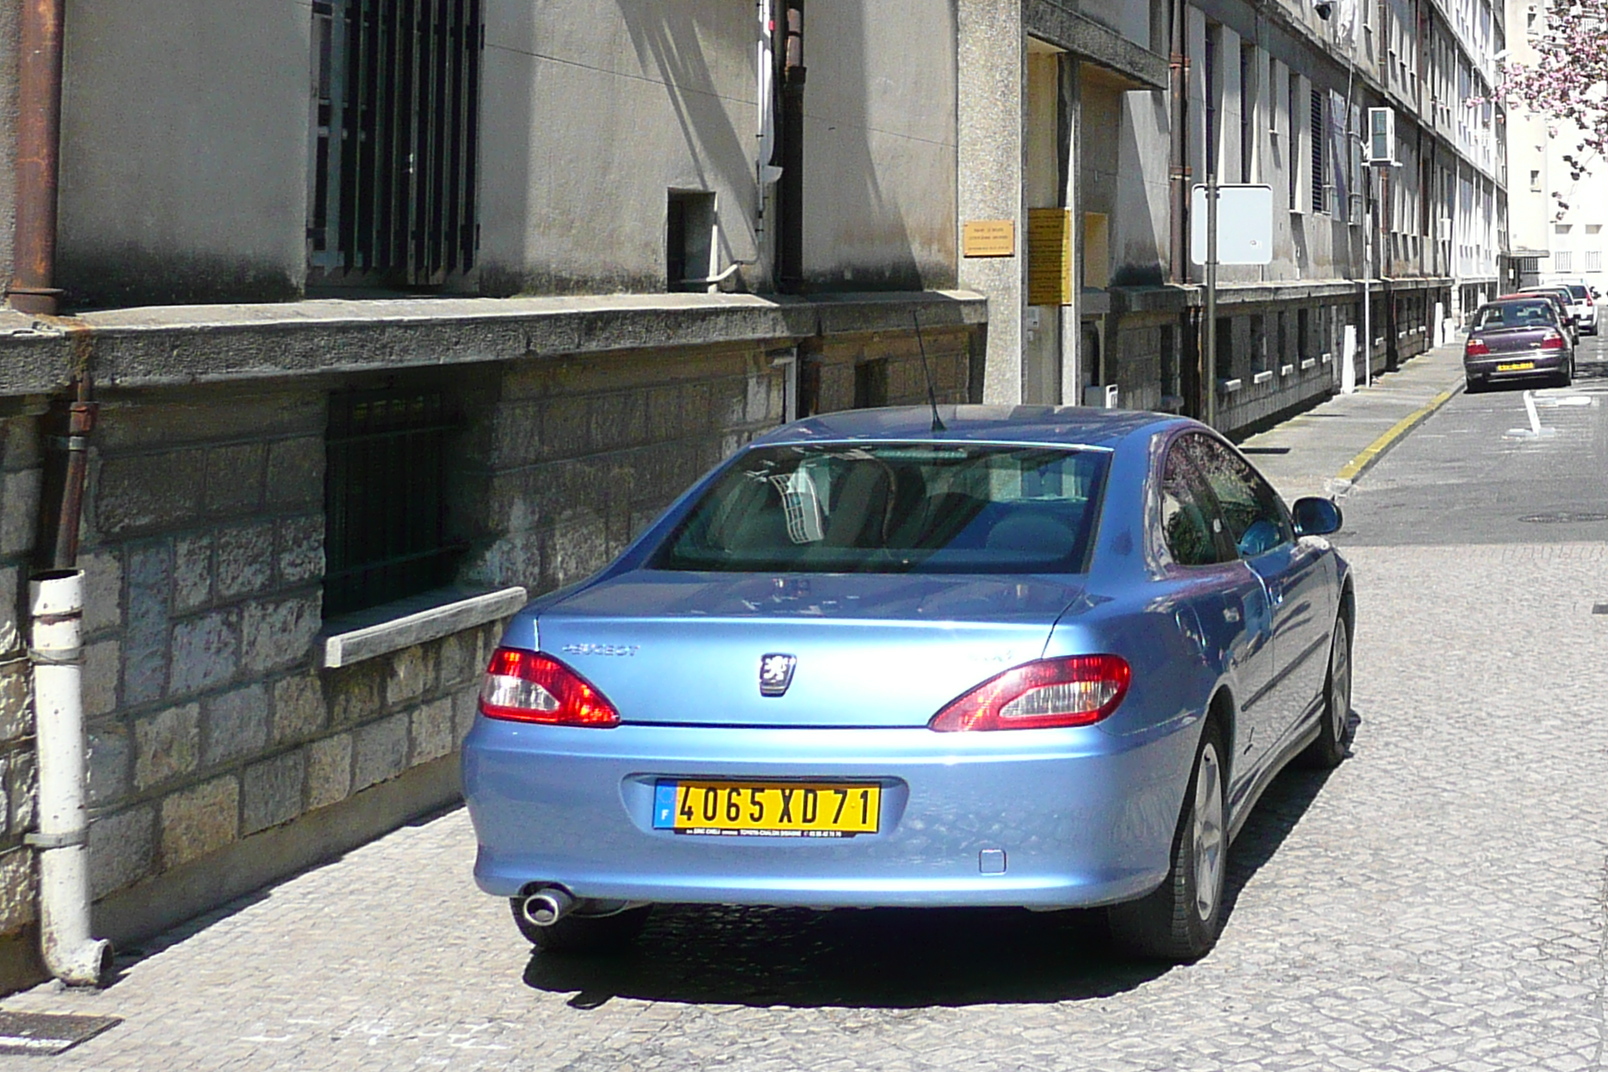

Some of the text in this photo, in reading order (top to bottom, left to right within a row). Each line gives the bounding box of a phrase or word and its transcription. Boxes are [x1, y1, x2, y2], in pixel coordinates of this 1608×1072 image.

[661, 809, 669, 821] F
[679, 786, 869, 825] 4065 XD 71
